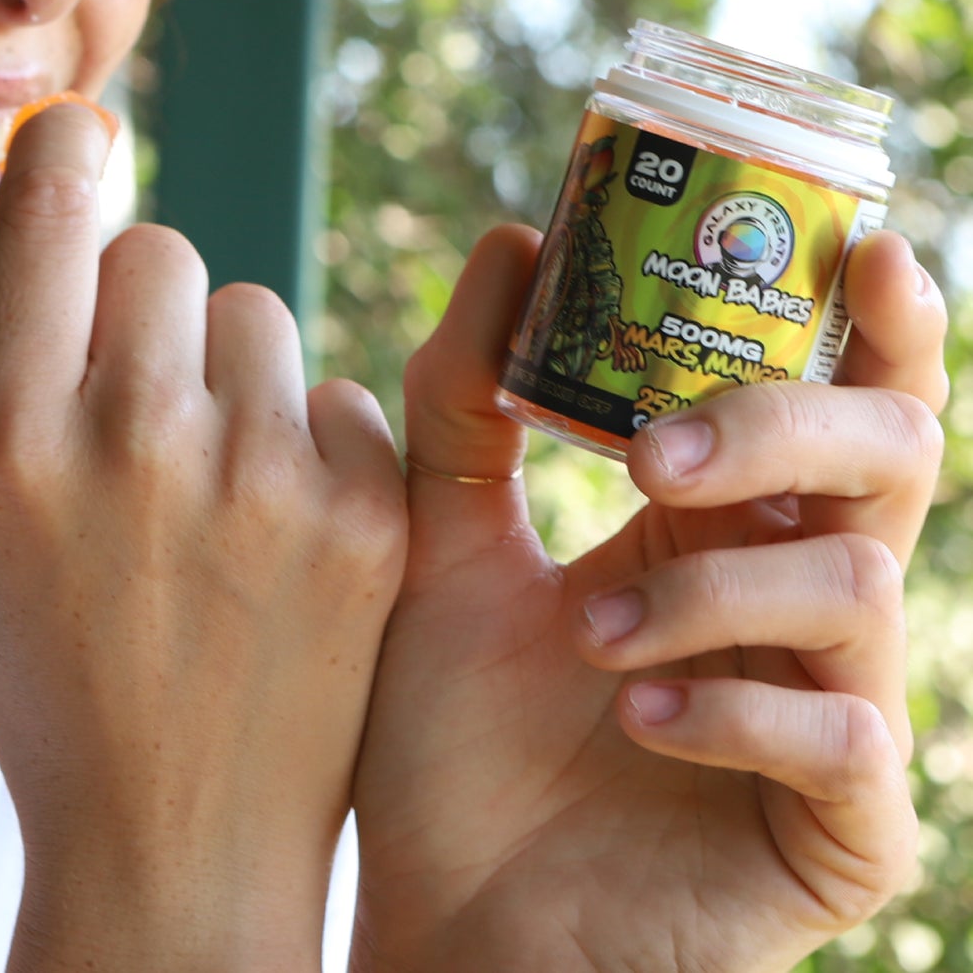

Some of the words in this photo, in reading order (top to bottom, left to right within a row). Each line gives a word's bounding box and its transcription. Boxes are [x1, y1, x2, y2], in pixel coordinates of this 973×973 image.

[630, 174, 678, 199] COUNT
[634, 151, 684, 183] 20
[703, 201, 757, 246] GALAXY
[763, 206, 786, 267] TREATS
[642, 252, 722, 296] MOON
[623, 325, 702, 370] MARS
[661, 314, 763, 362] 500MG
